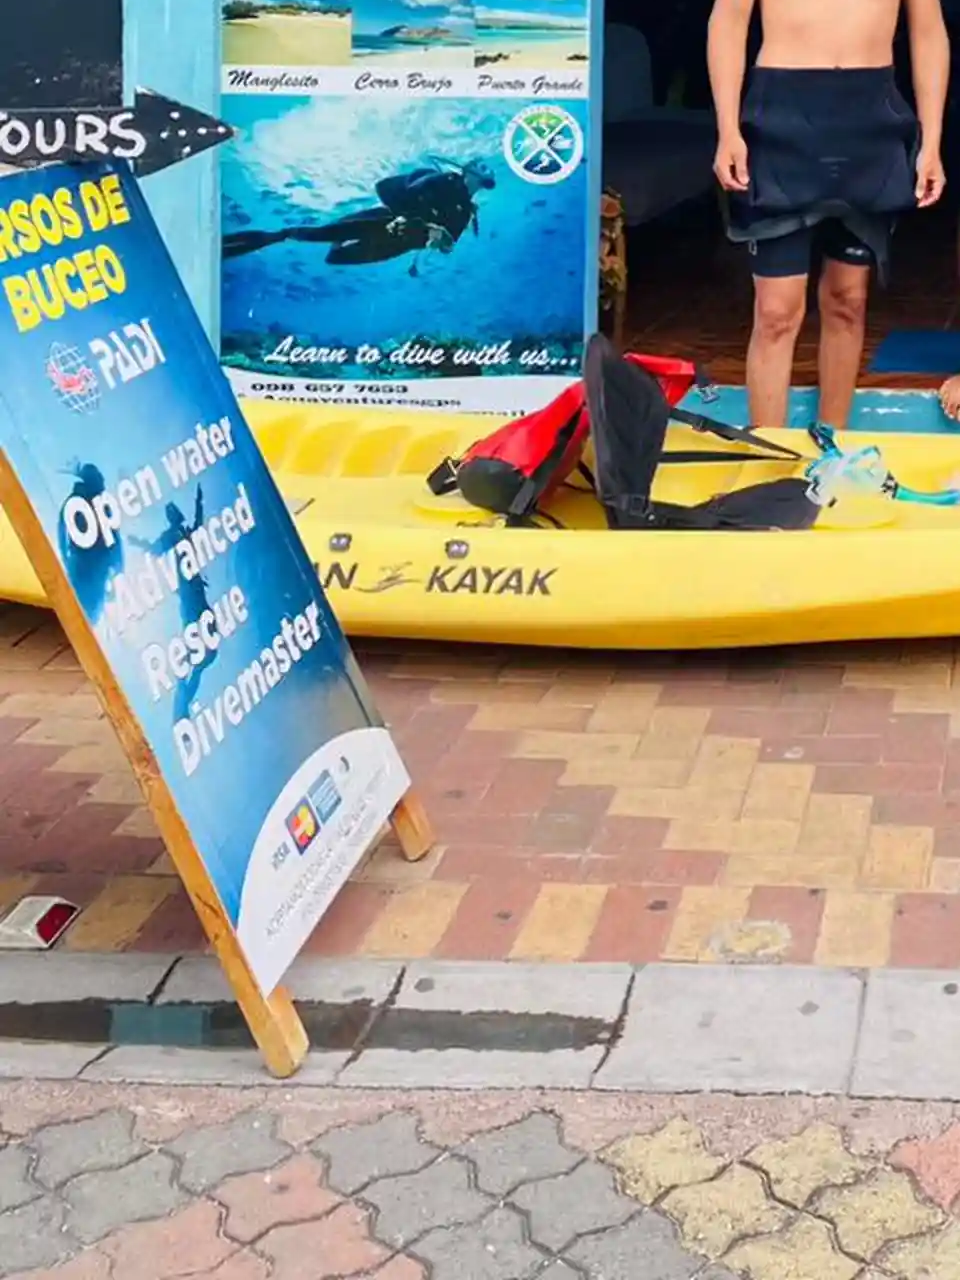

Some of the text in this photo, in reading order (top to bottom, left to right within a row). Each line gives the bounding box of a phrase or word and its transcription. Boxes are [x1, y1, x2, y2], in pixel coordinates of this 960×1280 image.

[228, 70, 320, 91] Manglesito
[354, 72, 454, 92] Cerro Brujo
[476, 74, 585, 93] Puerto Grande
[0, 111, 147, 158] OURS
[79, 174, 132, 232] DE
[2, 244, 127, 333] BUCEO
[88, 317, 166, 390] PADI
[263, 334, 348, 364] Learn
[355, 343, 381, 364] to
[389, 338, 446, 365] dive
[452, 339, 512, 367] with
[64, 465, 163, 550] Open
[108, 482, 255, 634] Advanced
[313, 561, 559, 595] N KAYAK
[141, 585, 249, 701] Rescue
[172, 601, 323, 777] Divemaster
